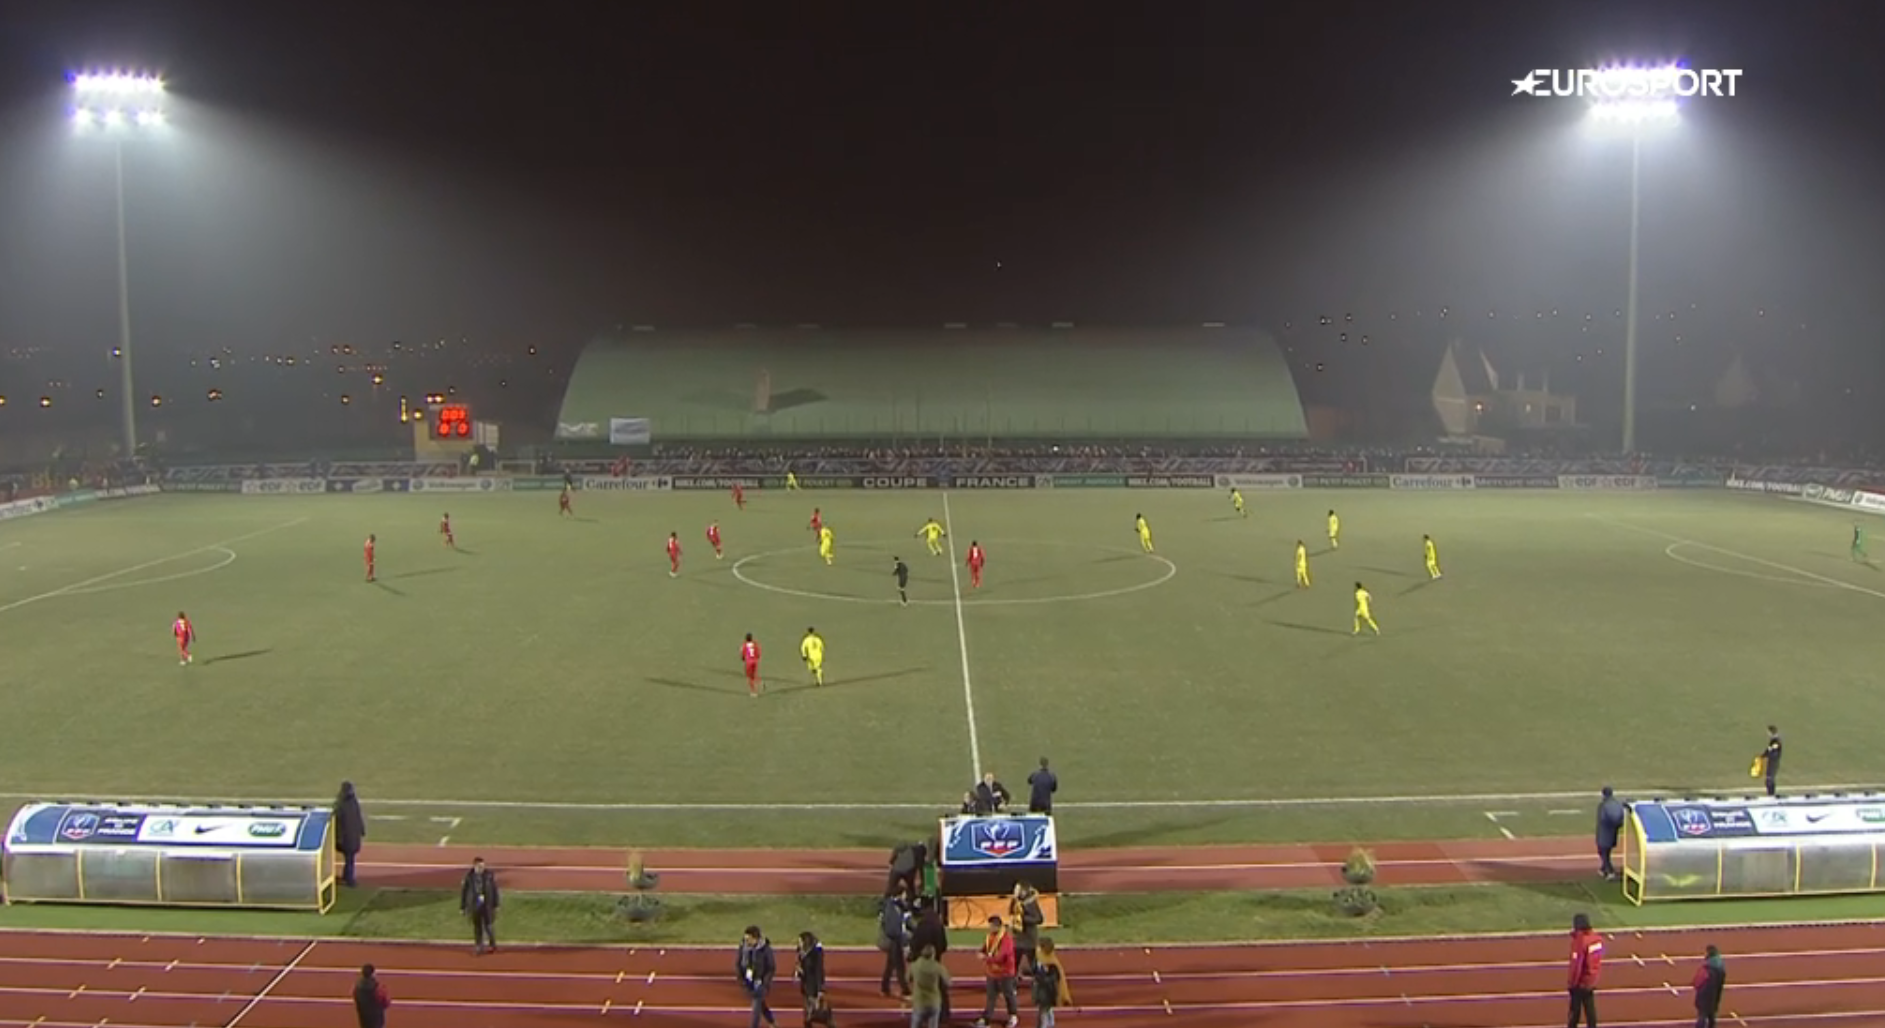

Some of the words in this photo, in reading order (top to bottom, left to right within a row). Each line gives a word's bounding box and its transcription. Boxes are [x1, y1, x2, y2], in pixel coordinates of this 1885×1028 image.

[585, 479, 649, 490] Carrefour
[863, 477, 927, 487] COUPE
[956, 477, 1029, 487] FRANCE
[1392, 476, 1453, 488] Carrefour
